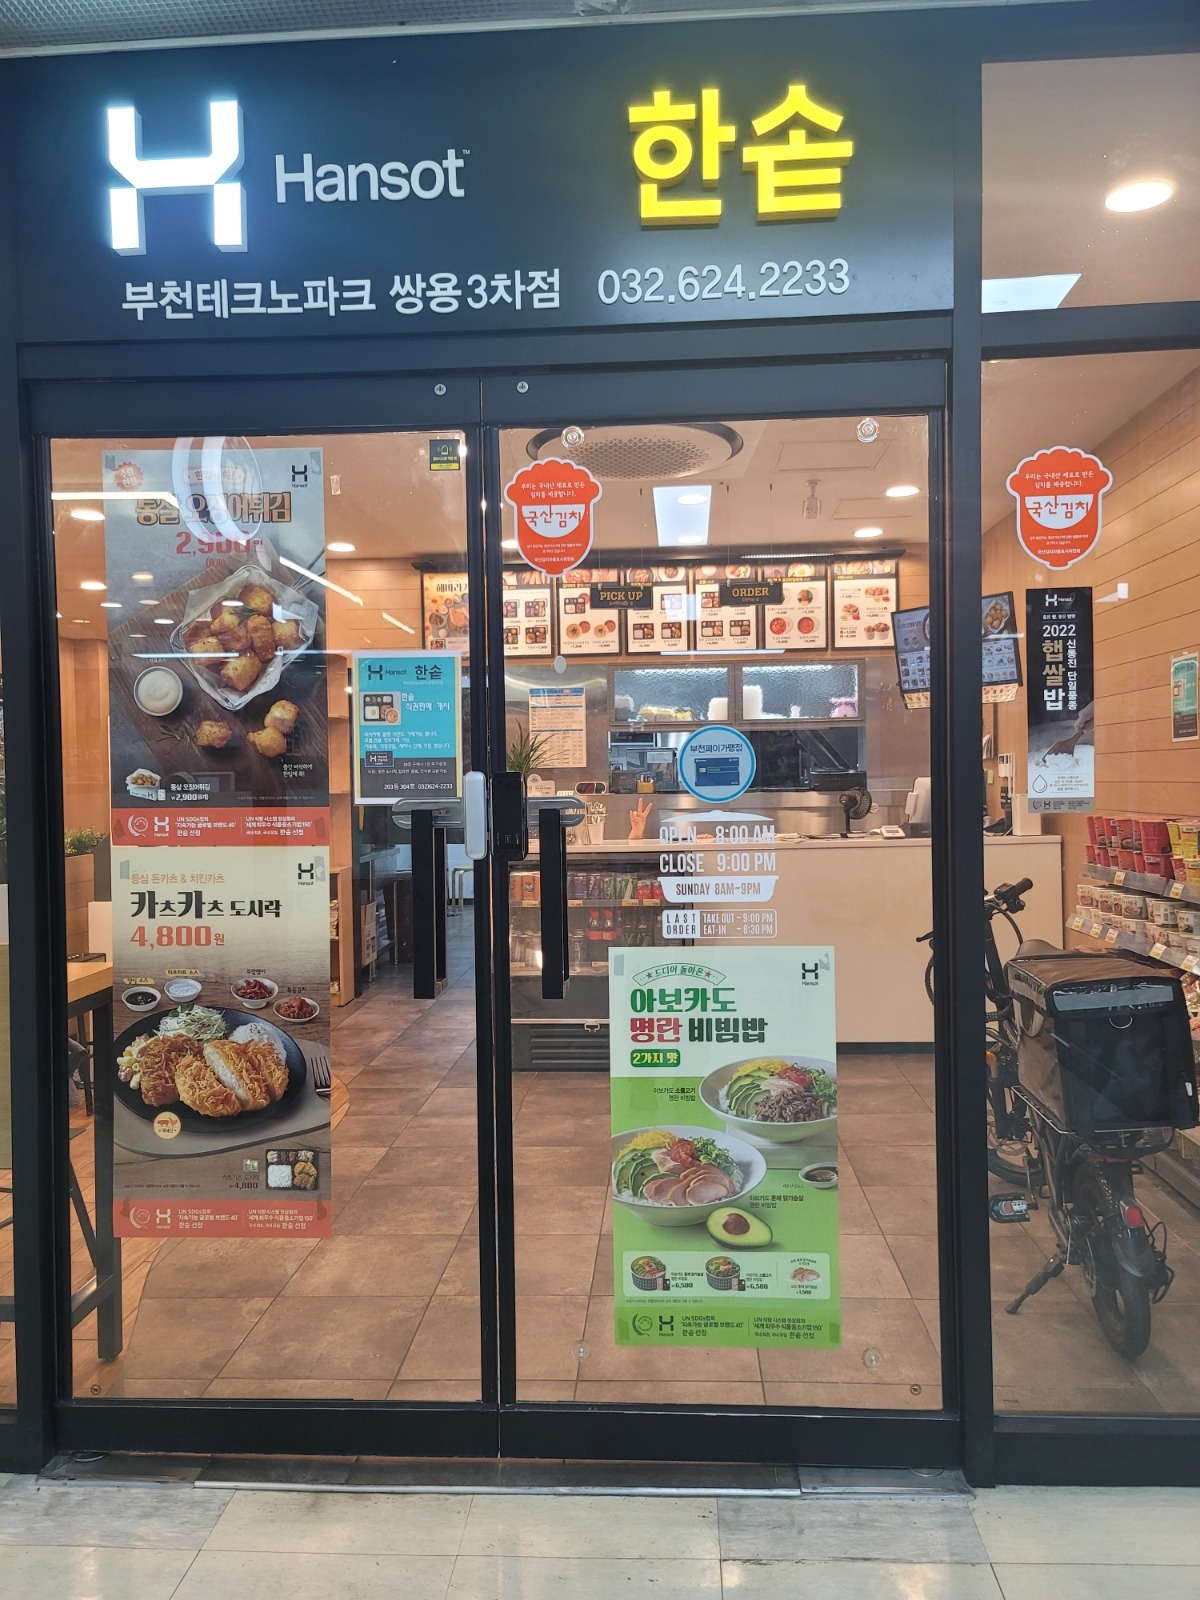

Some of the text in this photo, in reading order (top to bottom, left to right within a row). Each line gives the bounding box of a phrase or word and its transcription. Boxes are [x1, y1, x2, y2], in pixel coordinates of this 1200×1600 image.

[628, 84, 853, 229] 한솥
[275, 148, 465, 204] Hansot
[122, 257, 850, 321] 부천테크노파크 쌍용3차점 032.624.2233
[1024, 472, 1042, 480] 우리는
[1081, 470, 1094, 479] 만든
[1027, 496, 1089, 519] 국산김치
[525, 506, 582, 528] 국산김치
[600, 591, 643, 600] PICK UP
[732, 587, 770, 597] ORDER
[1042, 624, 1076, 637] 2022
[385, 668, 407, 676] Hansot
[414, 664, 443, 681] 한솥
[1067, 638, 1078, 711] 신동진 단일품종
[401, 692, 415, 702] 한솥
[689, 743, 743, 754] 부천페이가맹점
[177, 829, 188, 837] 한솥
[659, 825, 775, 844] OPEN 8:00 AM
[659, 852, 776, 873] CLOSE 9:00 PM
[130, 873, 149, 885] 등심
[151, 873, 178, 884] 돈카츠
[190, 872, 225, 884] 치킨카츠
[675, 882, 710, 896] SUNDAY
[130, 890, 283, 919] 카츠카츠 도시락
[666, 913, 696, 924] LAST
[702, 912, 773, 923] TAKE OUT 9:00 PM
[666, 925, 696, 935] ORDER
[703, 924, 773, 935] EAT-IN 8:30 PM
[130, 925, 225, 950] 4,800원
[654, 965, 704, 978] 드디어 돌아온
[630, 987, 737, 1013] 아보카도
[630, 1017, 768, 1043] 명란 비빔밥
[632, 1052, 680, 1064] 2가지 맛
[789, 1331, 801, 1339] 한솥
